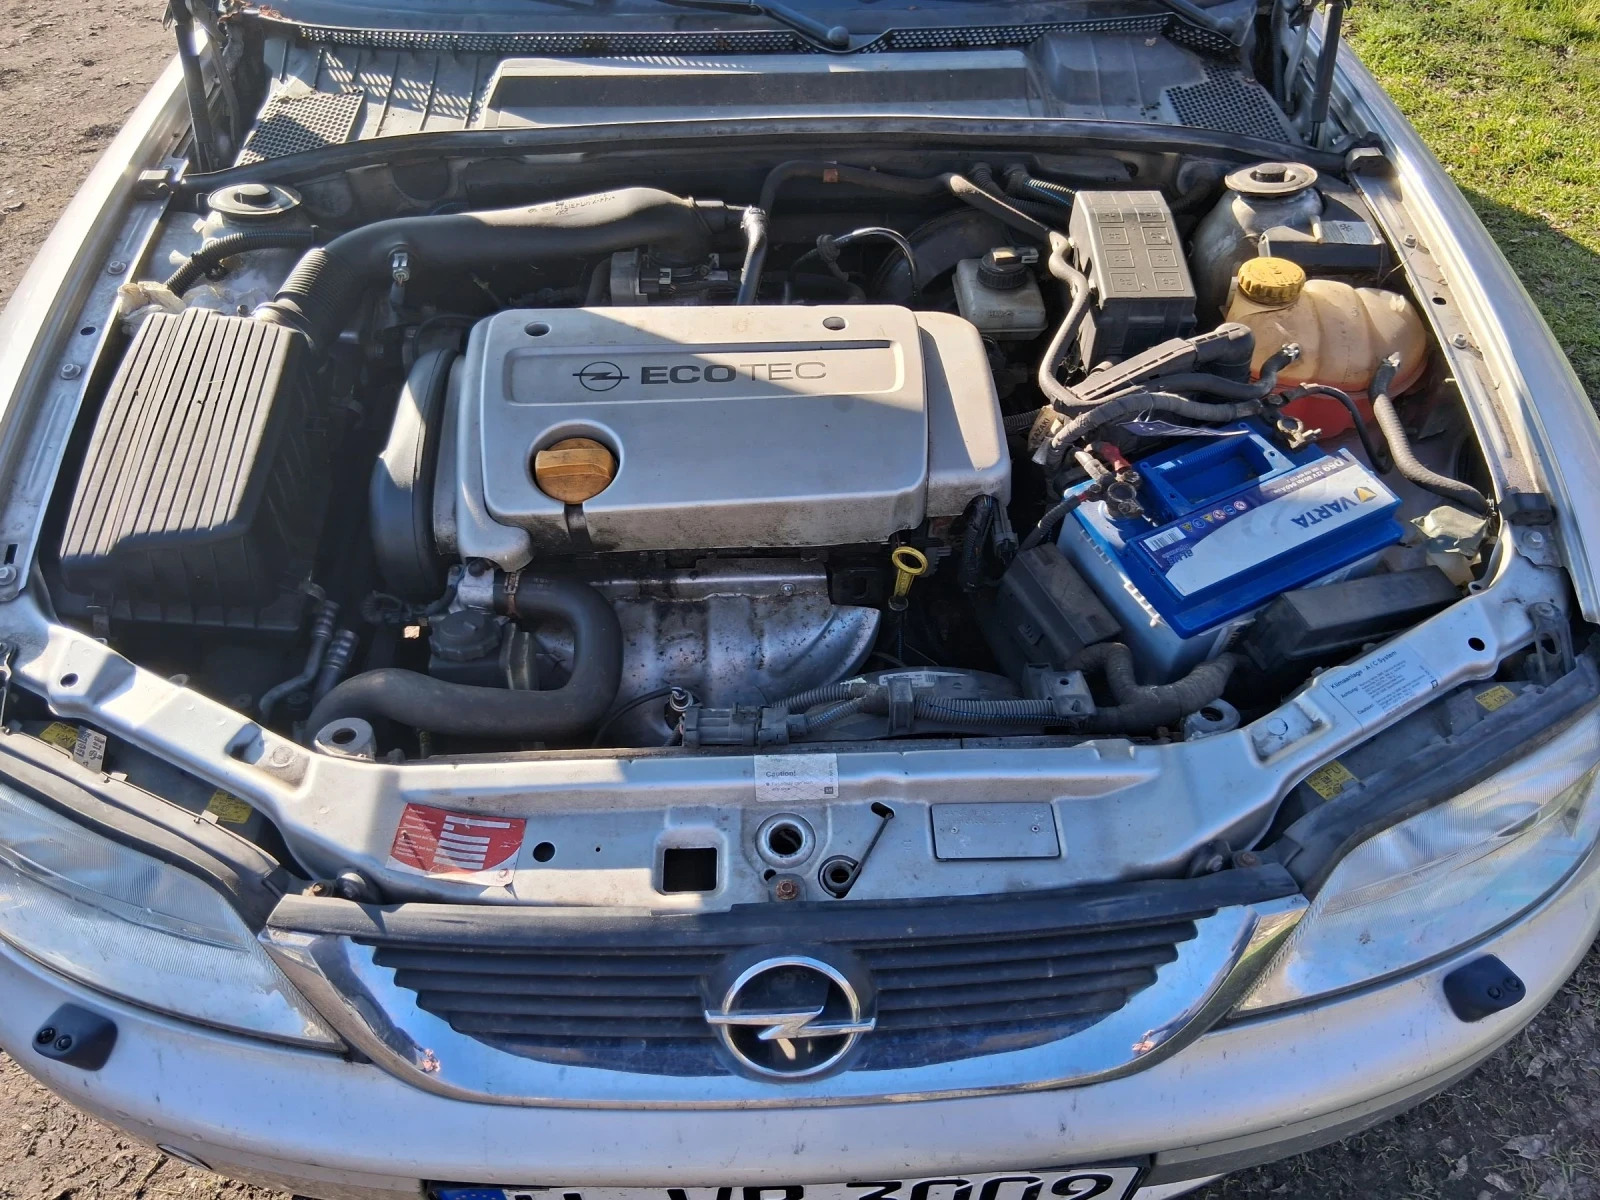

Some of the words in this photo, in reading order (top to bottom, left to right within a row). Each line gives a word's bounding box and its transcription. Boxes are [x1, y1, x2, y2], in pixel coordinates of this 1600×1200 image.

[640, 361, 827, 385] ECOTEC
[1290, 496, 1358, 528] VARTA
[1331, 669, 1363, 689] Klimaanlage
[1379, 650, 1397, 665] System
[765, 770, 796, 778] Caution!
